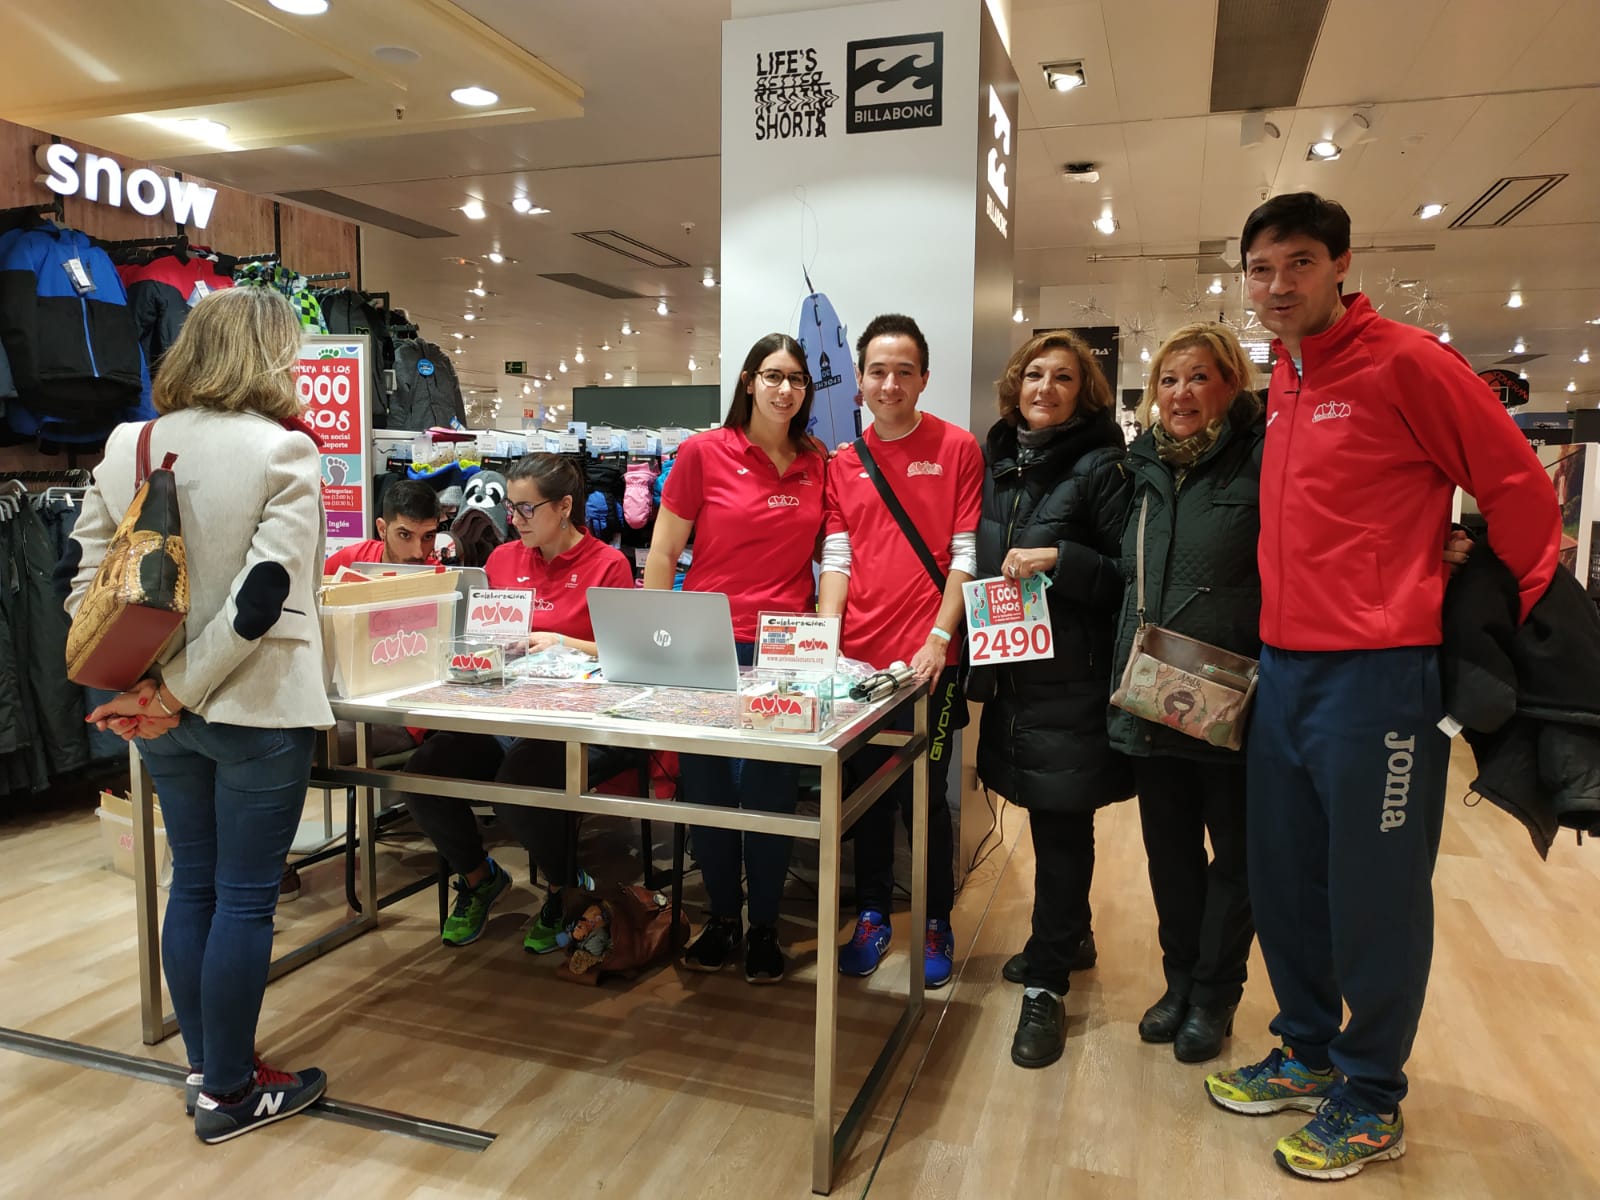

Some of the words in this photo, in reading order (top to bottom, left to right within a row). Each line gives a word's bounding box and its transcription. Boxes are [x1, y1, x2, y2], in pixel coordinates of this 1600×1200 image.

[756, 47, 818, 76] LIFE'S
[854, 103, 934, 124] BILLABONG
[45, 143, 218, 230] snow
[653, 629, 672, 648] hp
[972, 623, 1051, 661] 2490
[1379, 731, 1416, 833] Joma
[253, 1091, 285, 1117] N
